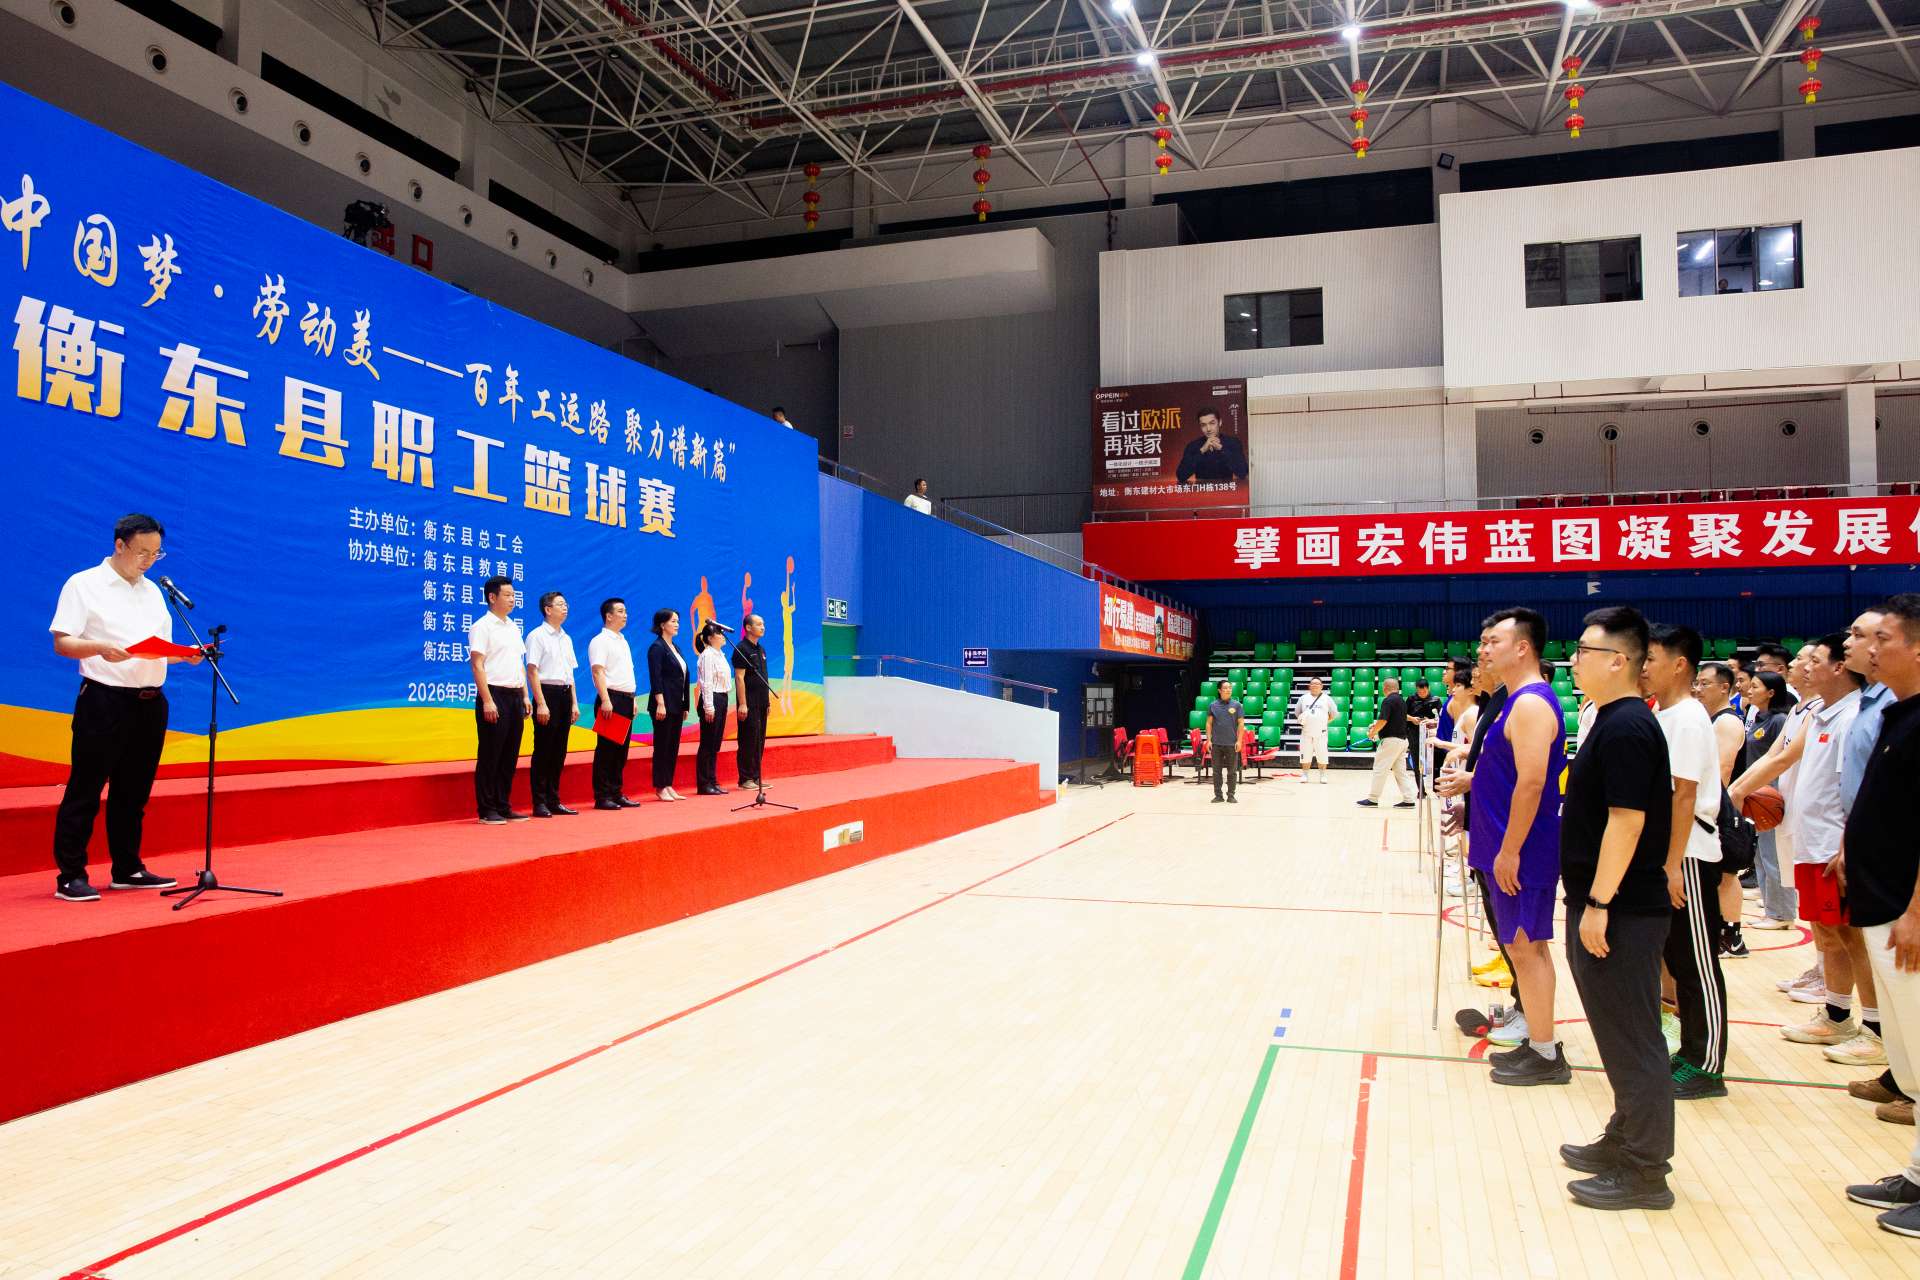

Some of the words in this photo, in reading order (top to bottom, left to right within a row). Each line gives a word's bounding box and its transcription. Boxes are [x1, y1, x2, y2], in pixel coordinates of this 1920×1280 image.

[1096, 392, 1120, 400] OPPEIN
[13, 295, 677, 539] 衡东县职工篮球赛
[1101, 407, 1182, 434] 看过欧派
[1103, 433, 1163, 457] 再装家
[407, 681, 479, 702] 2026年9月
